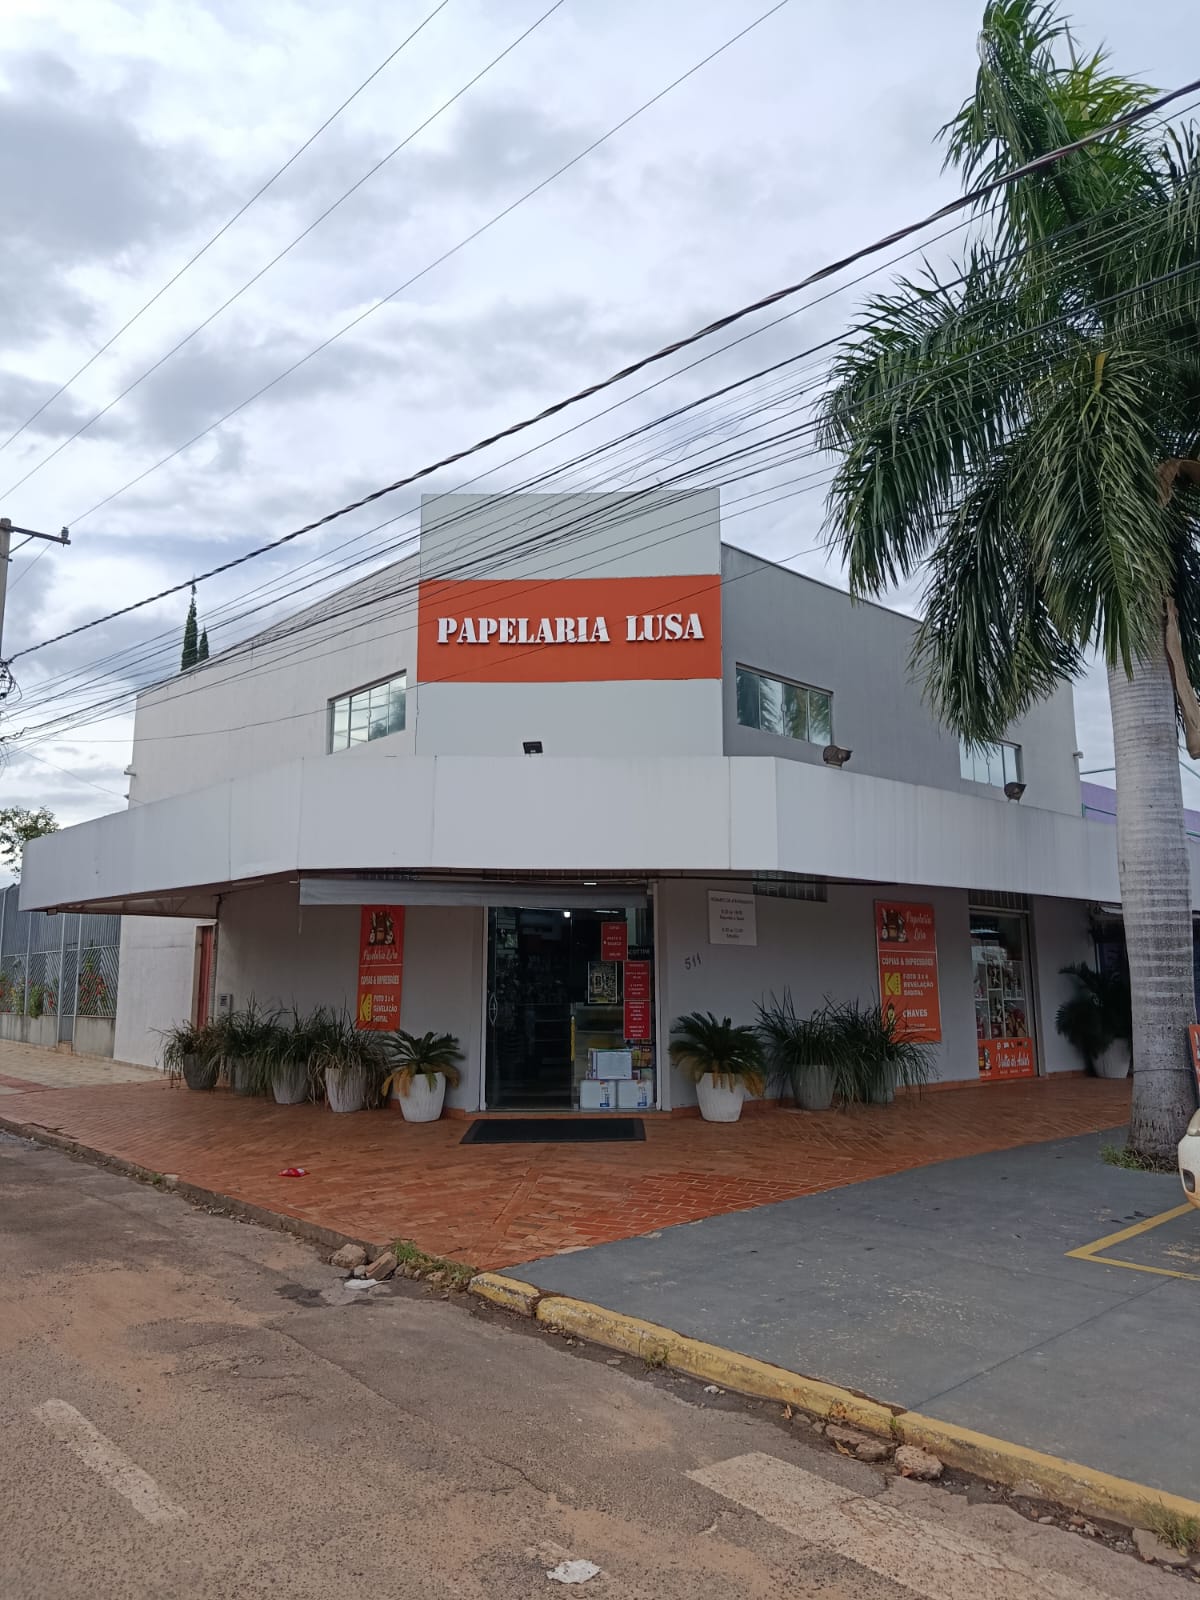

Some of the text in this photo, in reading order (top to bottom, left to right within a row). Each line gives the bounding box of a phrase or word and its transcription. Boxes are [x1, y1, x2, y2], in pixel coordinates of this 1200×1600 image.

[437, 613, 705, 644] PAPELARIA LUSA
[684, 952, 702, 970] 511
[903, 981, 934, 989] REVELAÇÃO
[902, 1008, 928, 1018] CHAVES
